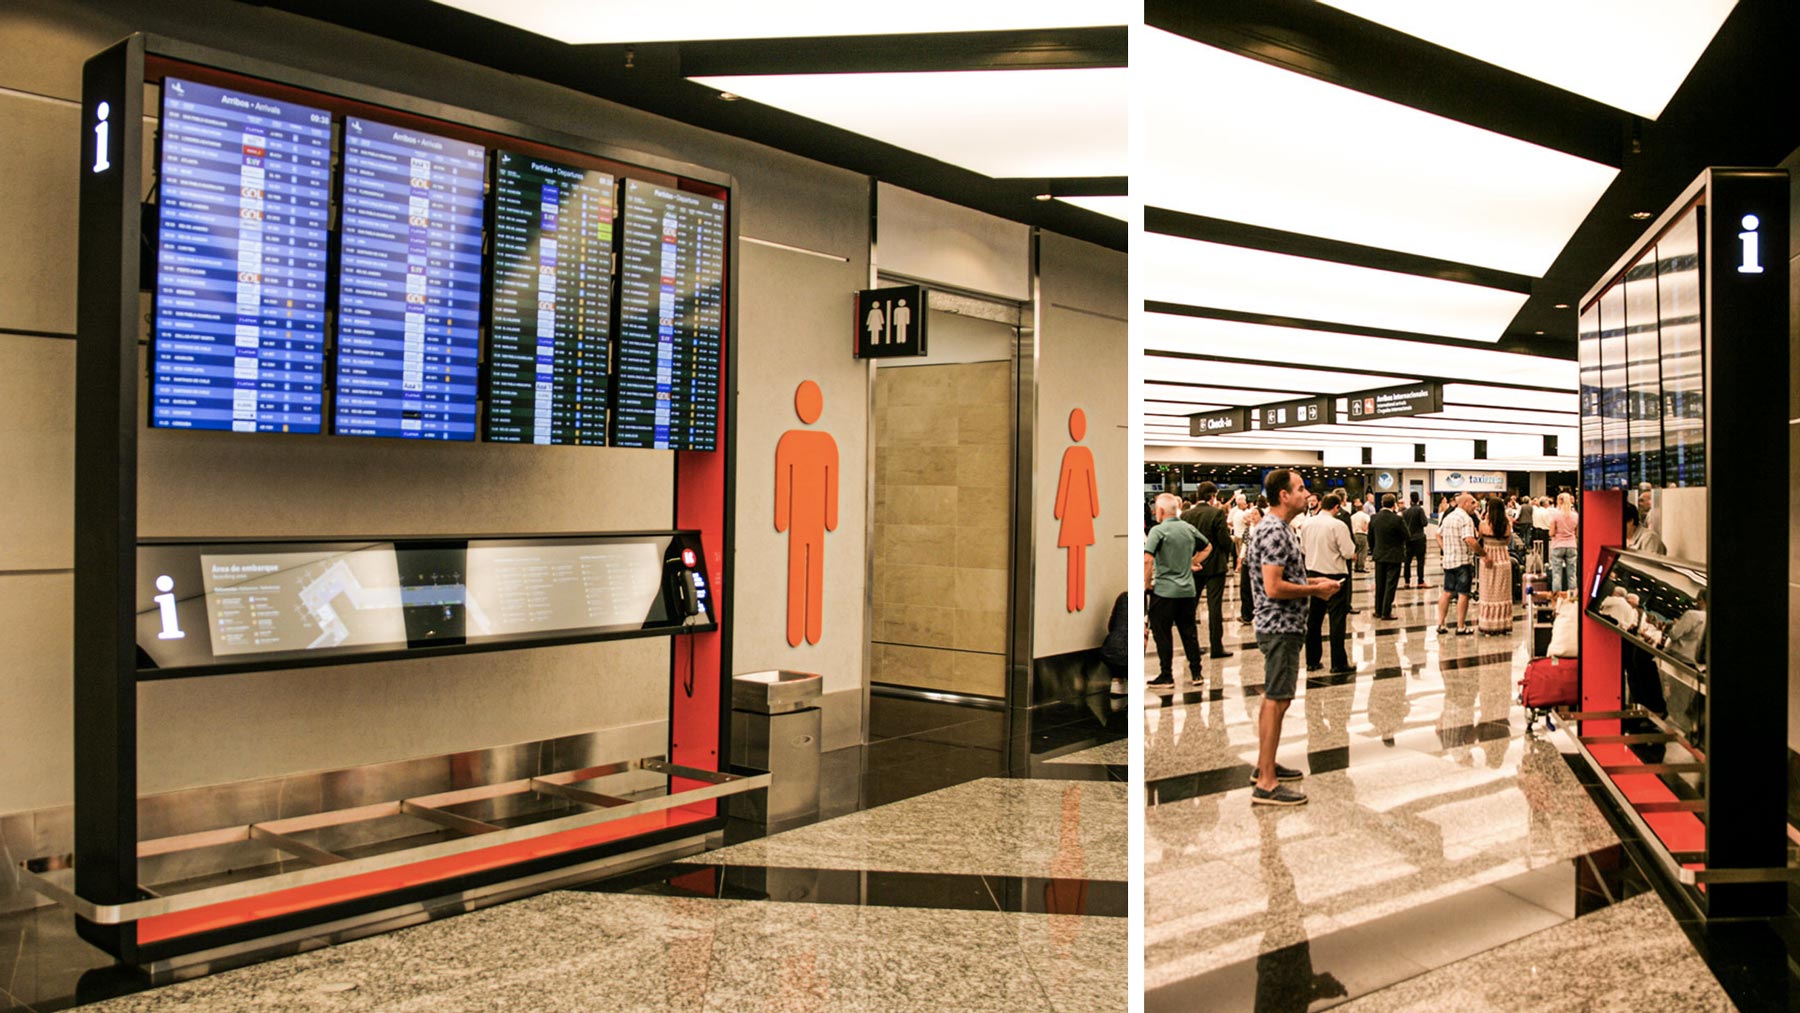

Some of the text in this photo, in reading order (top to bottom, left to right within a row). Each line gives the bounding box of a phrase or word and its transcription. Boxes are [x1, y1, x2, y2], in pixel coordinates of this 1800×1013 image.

[221, 95, 281, 114] Arribos Arrivals
[393, 132, 443, 150] Arribos Arrivals
[531, 162, 584, 179] Partidas Departures
[411, 179, 430, 189] GOL
[241, 188, 263, 198] GOL
[240, 209, 262, 220] GOL
[409, 217, 429, 227] GOL
[238, 272, 260, 283] GOL
[1207, 416, 1233, 430] Check-in
[231, 564, 241, 572] de
[241, 564, 279, 573] embarque
